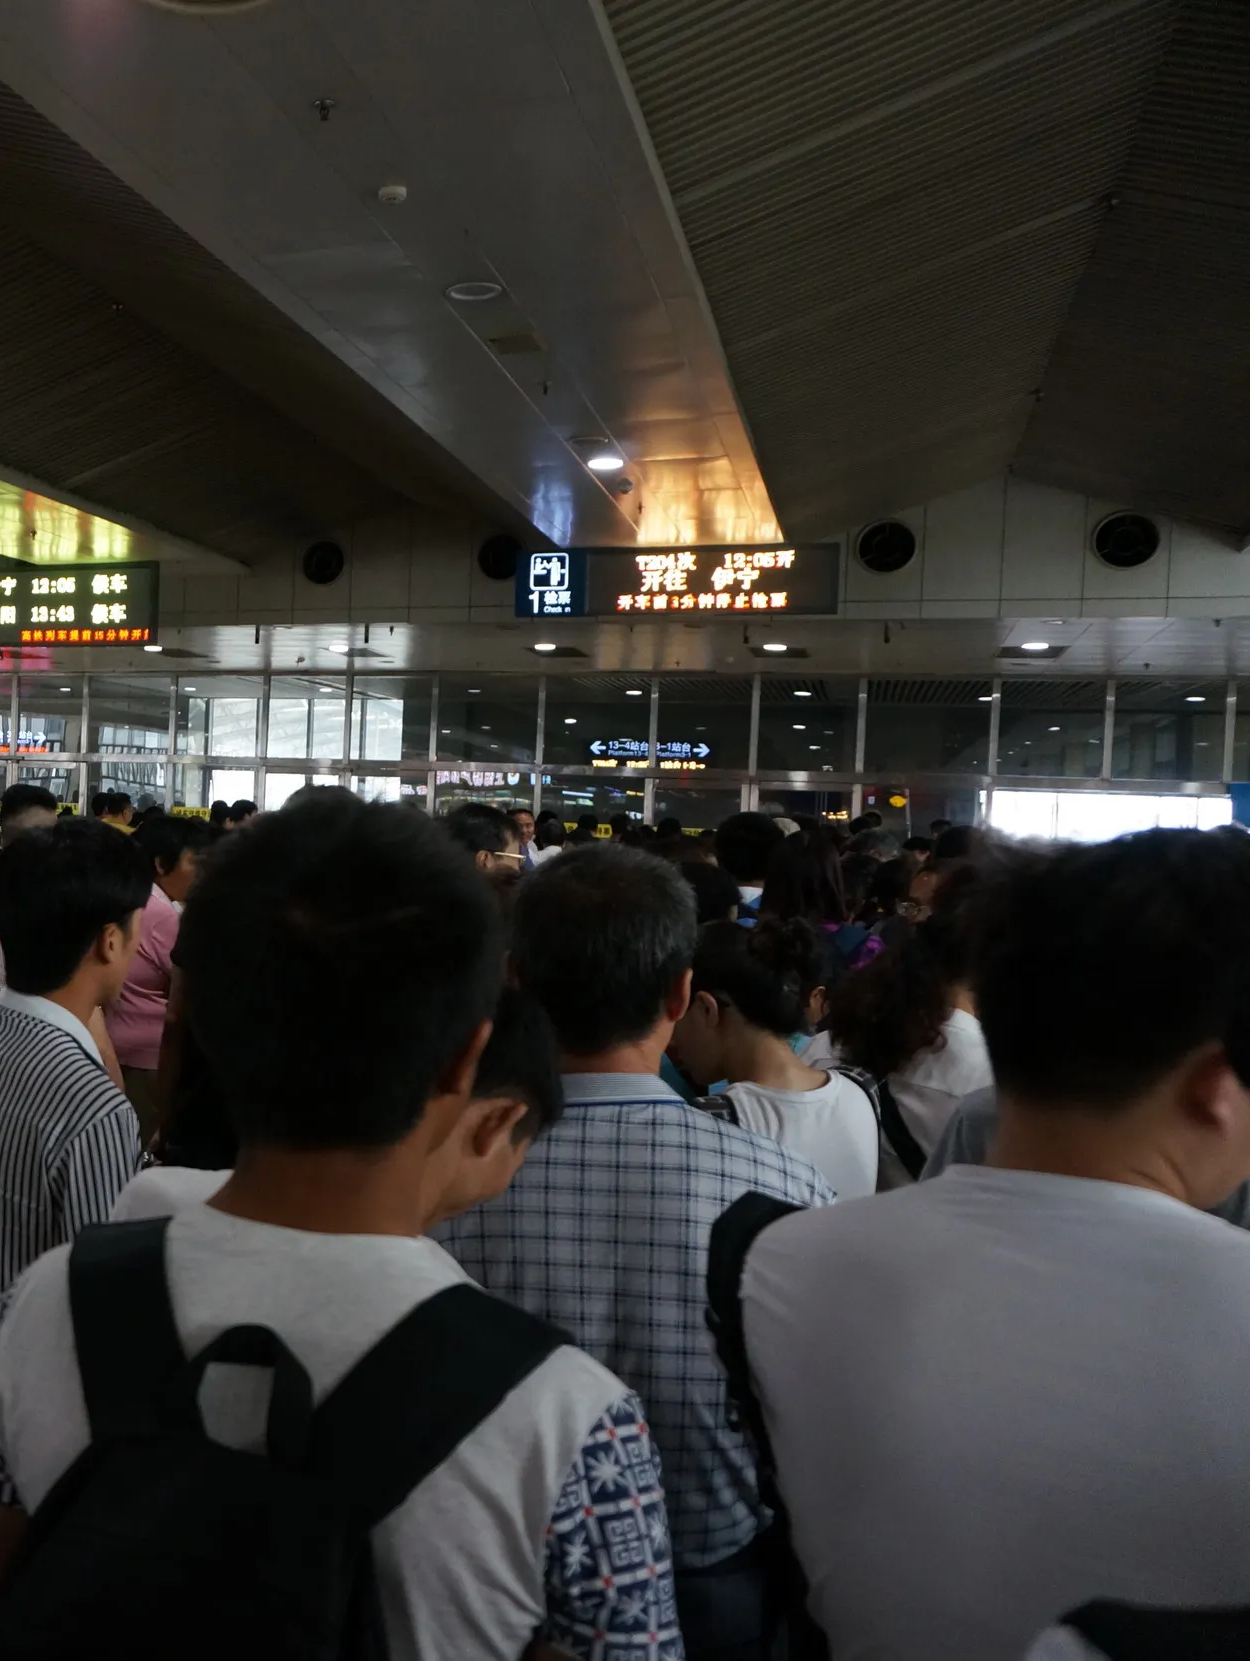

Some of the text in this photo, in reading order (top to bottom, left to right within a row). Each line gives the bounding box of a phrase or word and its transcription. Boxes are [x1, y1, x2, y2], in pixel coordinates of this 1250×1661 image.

[723, 549, 795, 569] 12:05开
[31, 576, 76, 594] 12:05
[91, 573, 128, 594] 候车
[640, 567, 760, 592] 开往 伊宁
[543, 590, 572, 605] 检票
[30, 604, 75, 623] 13:43
[91, 602, 127, 624] 候车
